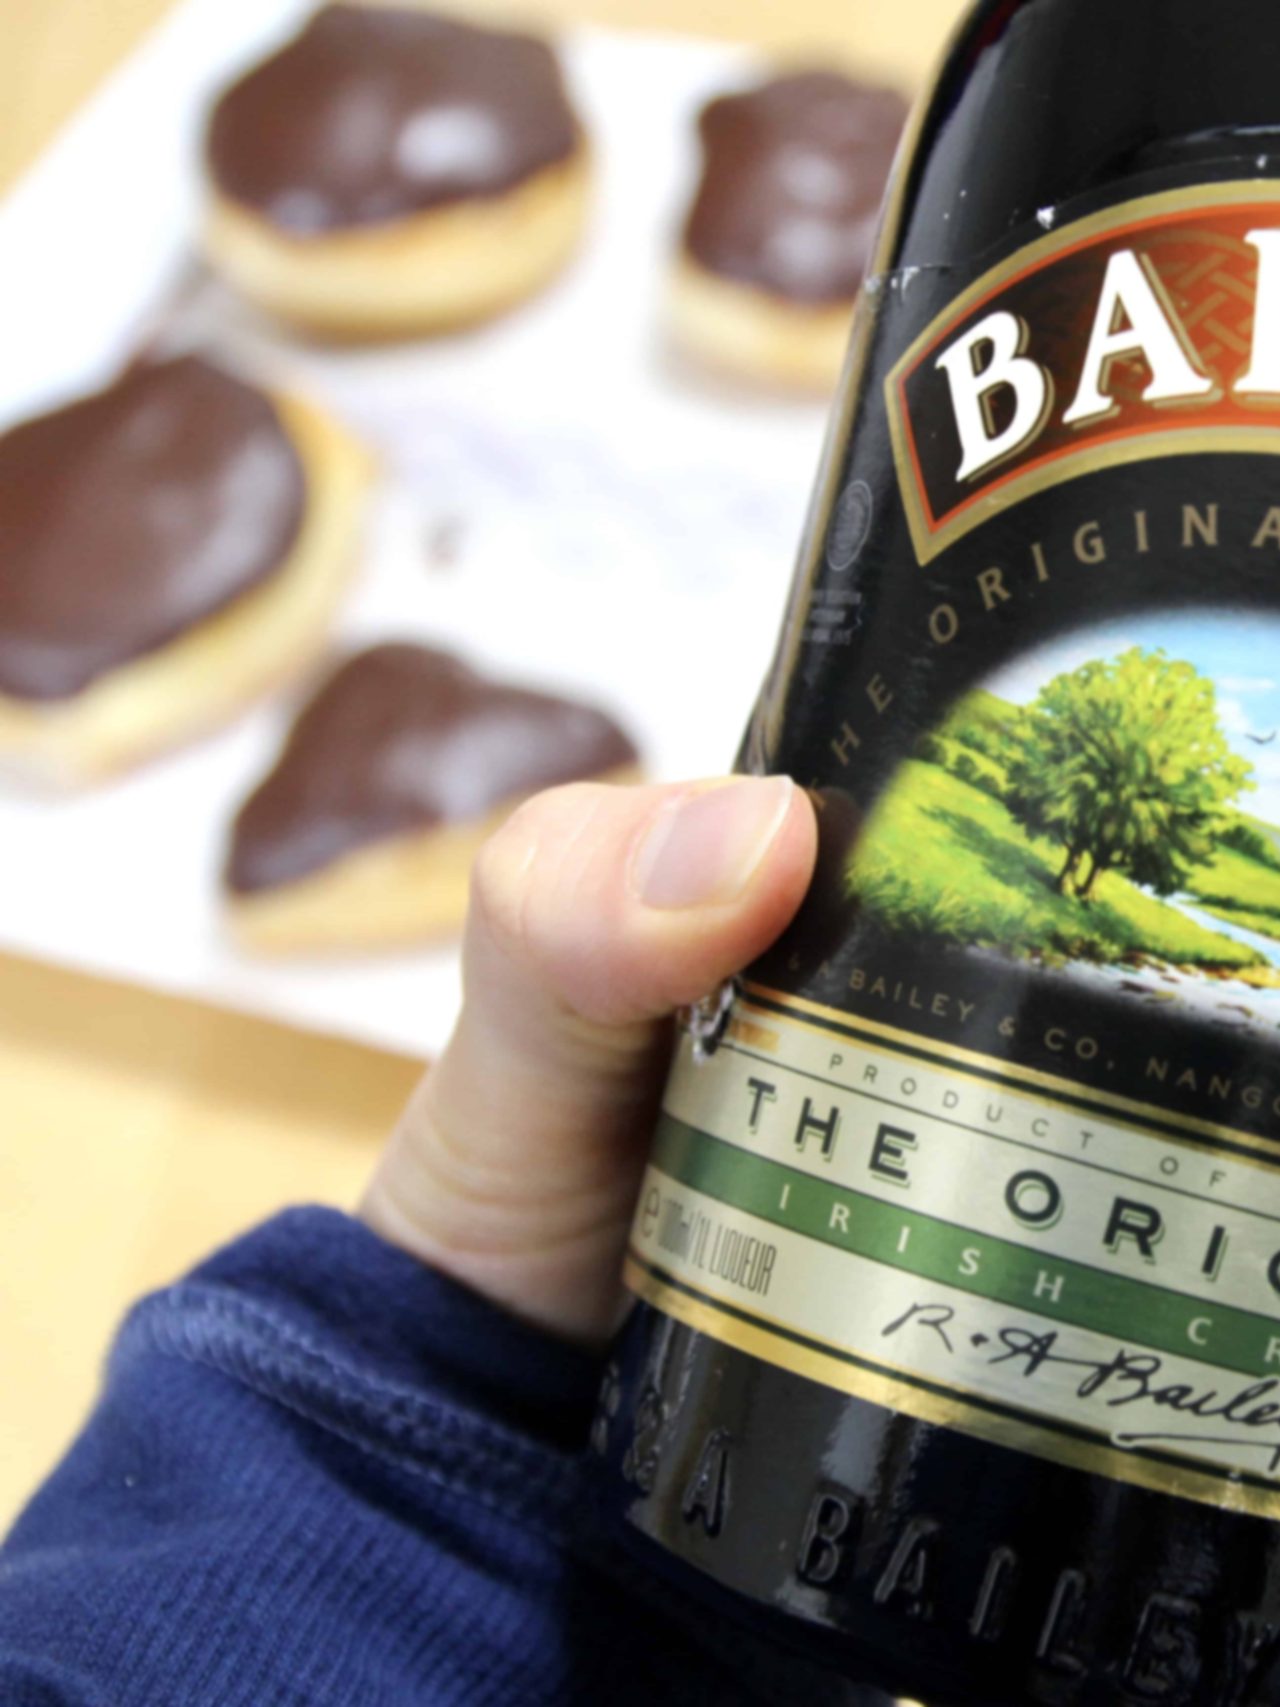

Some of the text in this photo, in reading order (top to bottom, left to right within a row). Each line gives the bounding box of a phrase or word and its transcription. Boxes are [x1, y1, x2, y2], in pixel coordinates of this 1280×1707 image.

[848, 968, 976, 1023] BAILEY
[997, 1015, 1018, 1038] &
[746, 1076, 918, 1188] THE
[829, 1053, 1094, 1150] PRODUCT
[1159, 1155, 1226, 1189] OF
[708, 1225, 777, 1297] LIQUEUR
[779, 1183, 1065, 1302] IRISH
